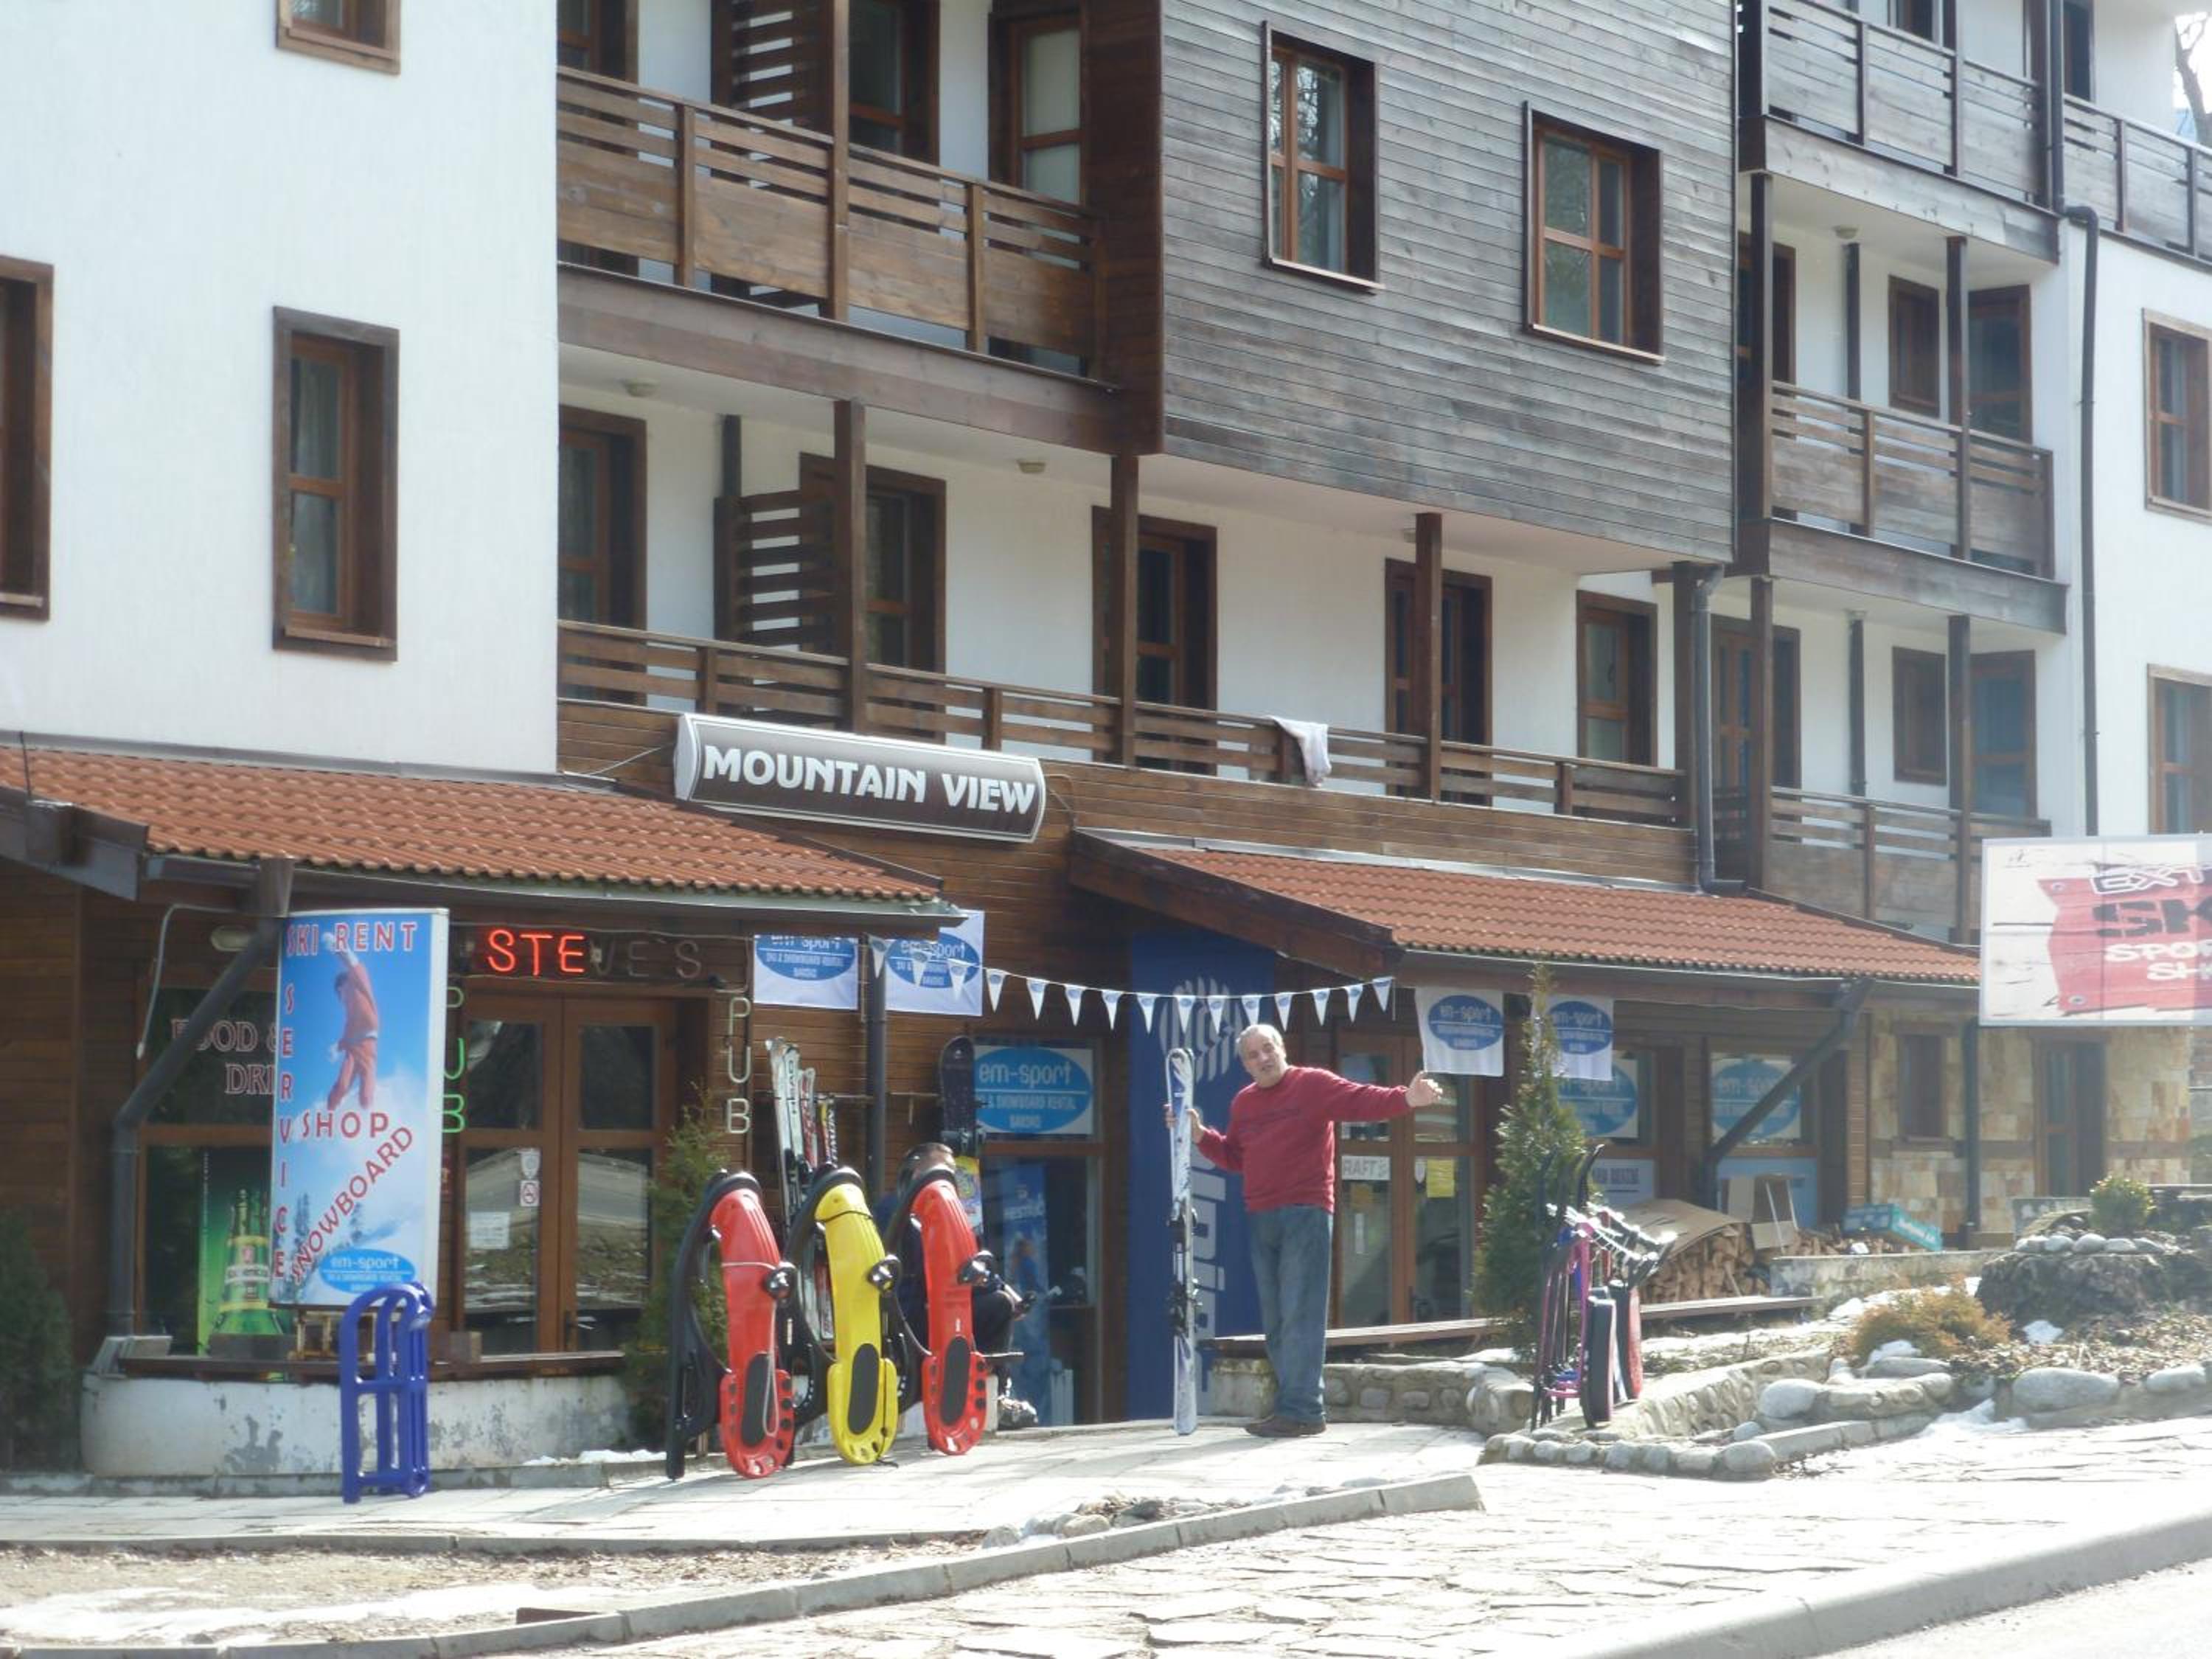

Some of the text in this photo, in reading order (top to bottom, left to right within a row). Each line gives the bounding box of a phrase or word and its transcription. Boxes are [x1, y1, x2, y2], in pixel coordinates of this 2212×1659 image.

[703, 745, 1035, 814] MOUNTAIN VIEW
[286, 921, 417, 956] SKI RENT
[487, 928, 703, 979] STEVE'S
[727, 996, 751, 1133] PUB
[978, 1062, 1072, 1089] em-sport
[274, 982, 294, 1278] SERVICE
[302, 1111, 389, 1138] SHOP
[291, 1126, 413, 1284] SNOWBOARD
